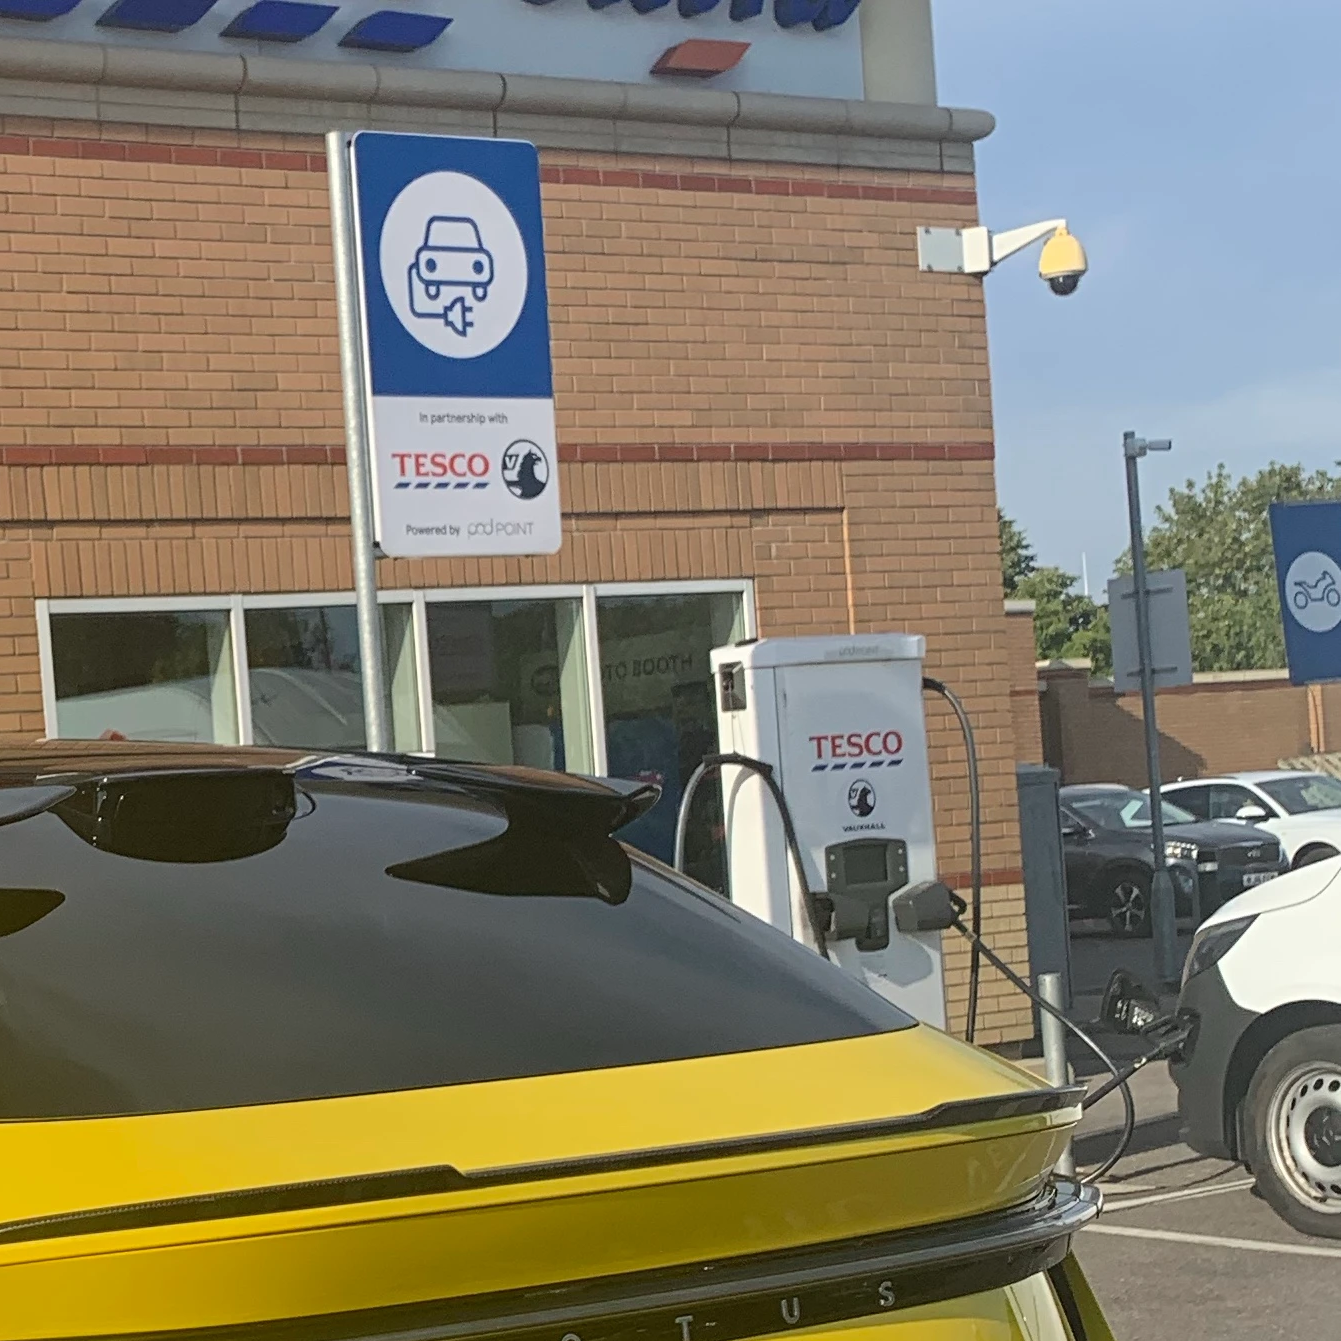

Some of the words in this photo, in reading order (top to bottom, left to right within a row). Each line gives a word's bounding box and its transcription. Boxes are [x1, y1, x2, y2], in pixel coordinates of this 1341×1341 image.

[419, 412, 428, 423] In
[430, 412, 486, 426] partnership
[488, 412, 508, 424] with
[391, 453, 490, 477] TESCO
[405, 524, 447, 536] Powered
[449, 525, 460, 538] by
[495, 521, 534, 536] POINT
[809, 731, 903, 759] TESCO
[842, 822, 886, 832] VAUXHALL
